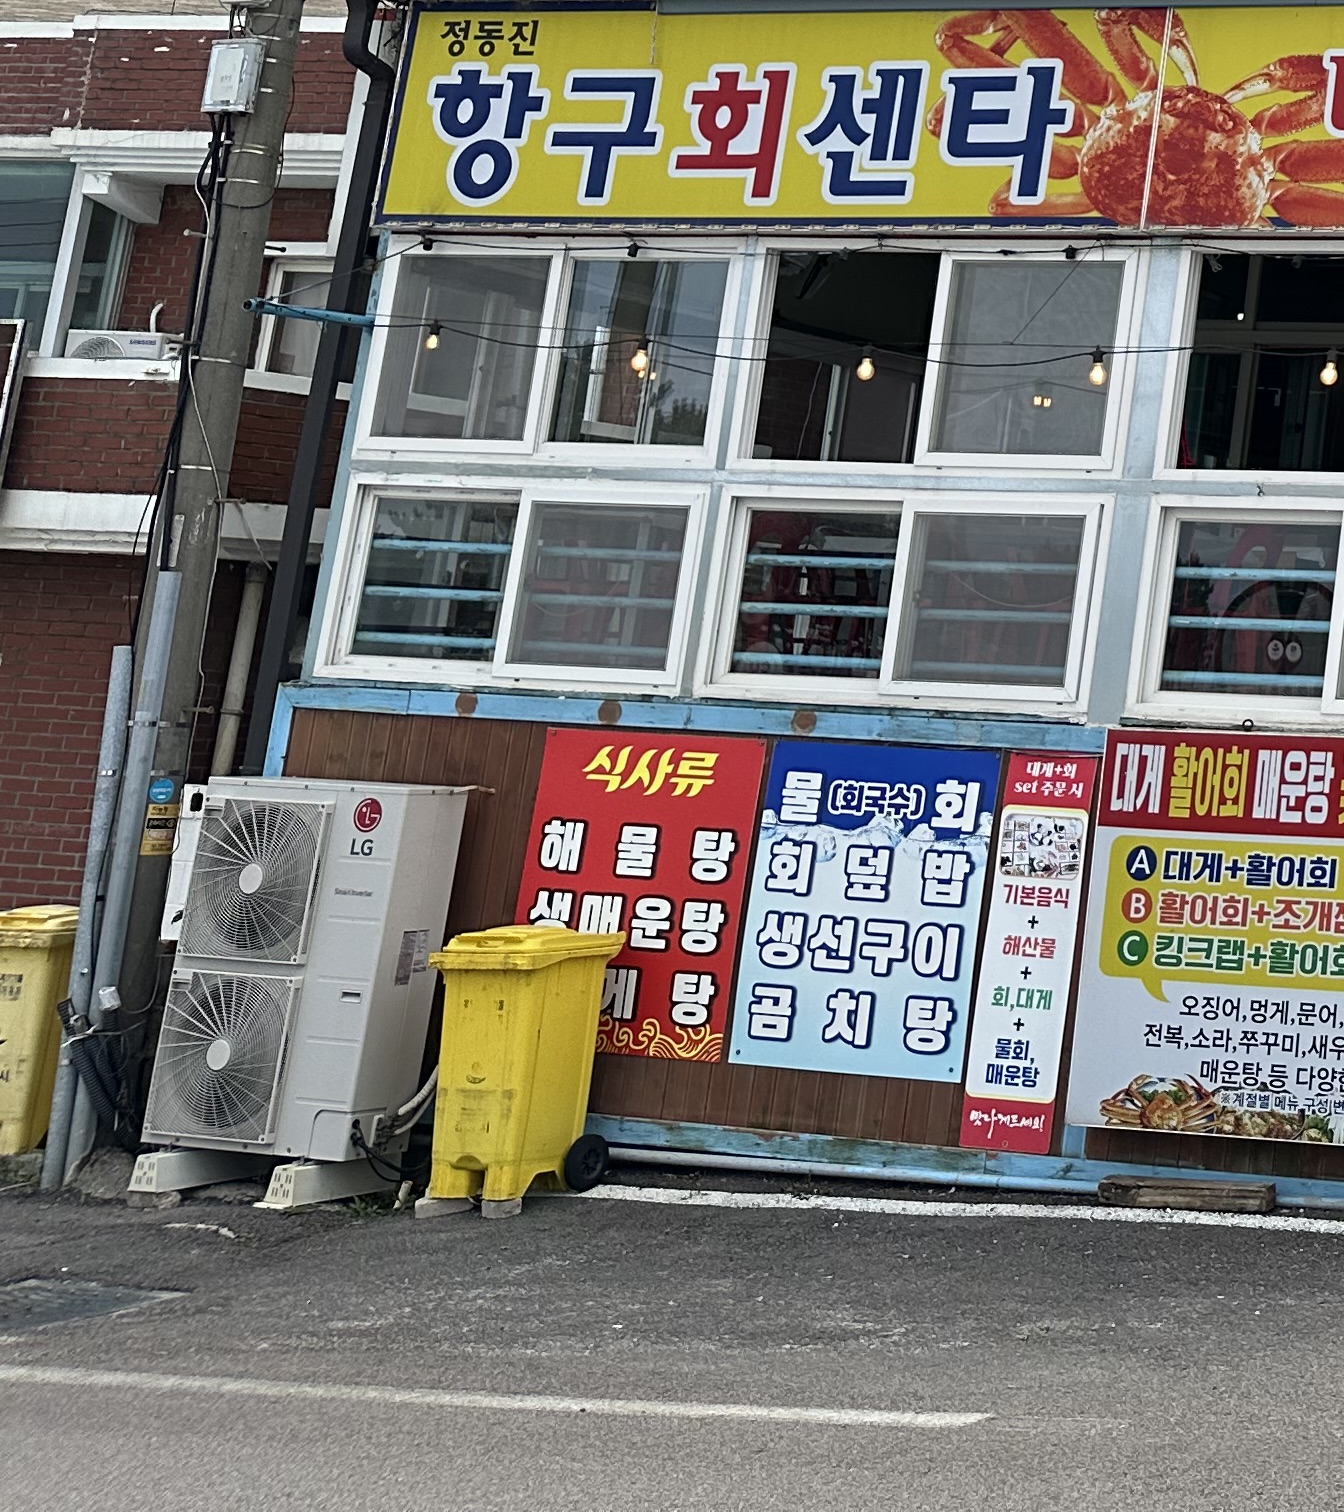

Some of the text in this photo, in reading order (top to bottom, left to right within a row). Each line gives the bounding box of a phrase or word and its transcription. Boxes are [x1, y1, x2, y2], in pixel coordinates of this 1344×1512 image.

[440, 20, 539, 57] 정동진
[434, 65, 1069, 199] 항구회센타
[583, 745, 720, 797] 식사류
[1110, 745, 1166, 815] 대게
[1168, 743, 1249, 819] 활어회
[1252, 751, 1336, 824] 매운탕
[1014, 780, 1038, 793] set
[350, 838, 374, 856] LG
[539, 818, 735, 883] 해물탕
[766, 840, 973, 908] 회덮밥
[1131, 850, 1338, 889] A 대게+활어회
[1002, 885, 1071, 909] 기본음식
[1129, 894, 1146, 917] B
[758, 912, 962, 981] 생선구이
[1002, 935, 1056, 959] 해산물
[1123, 936, 1139, 959] C
[991, 986, 1053, 1011] 회,대게
[748, 983, 956, 1055] 곰치탕
[986, 1062, 1039, 1088] 매운탕
[1200, 1059, 1263, 1087] 매운탕
[1274, 1096, 1299, 1112] 메뉴
